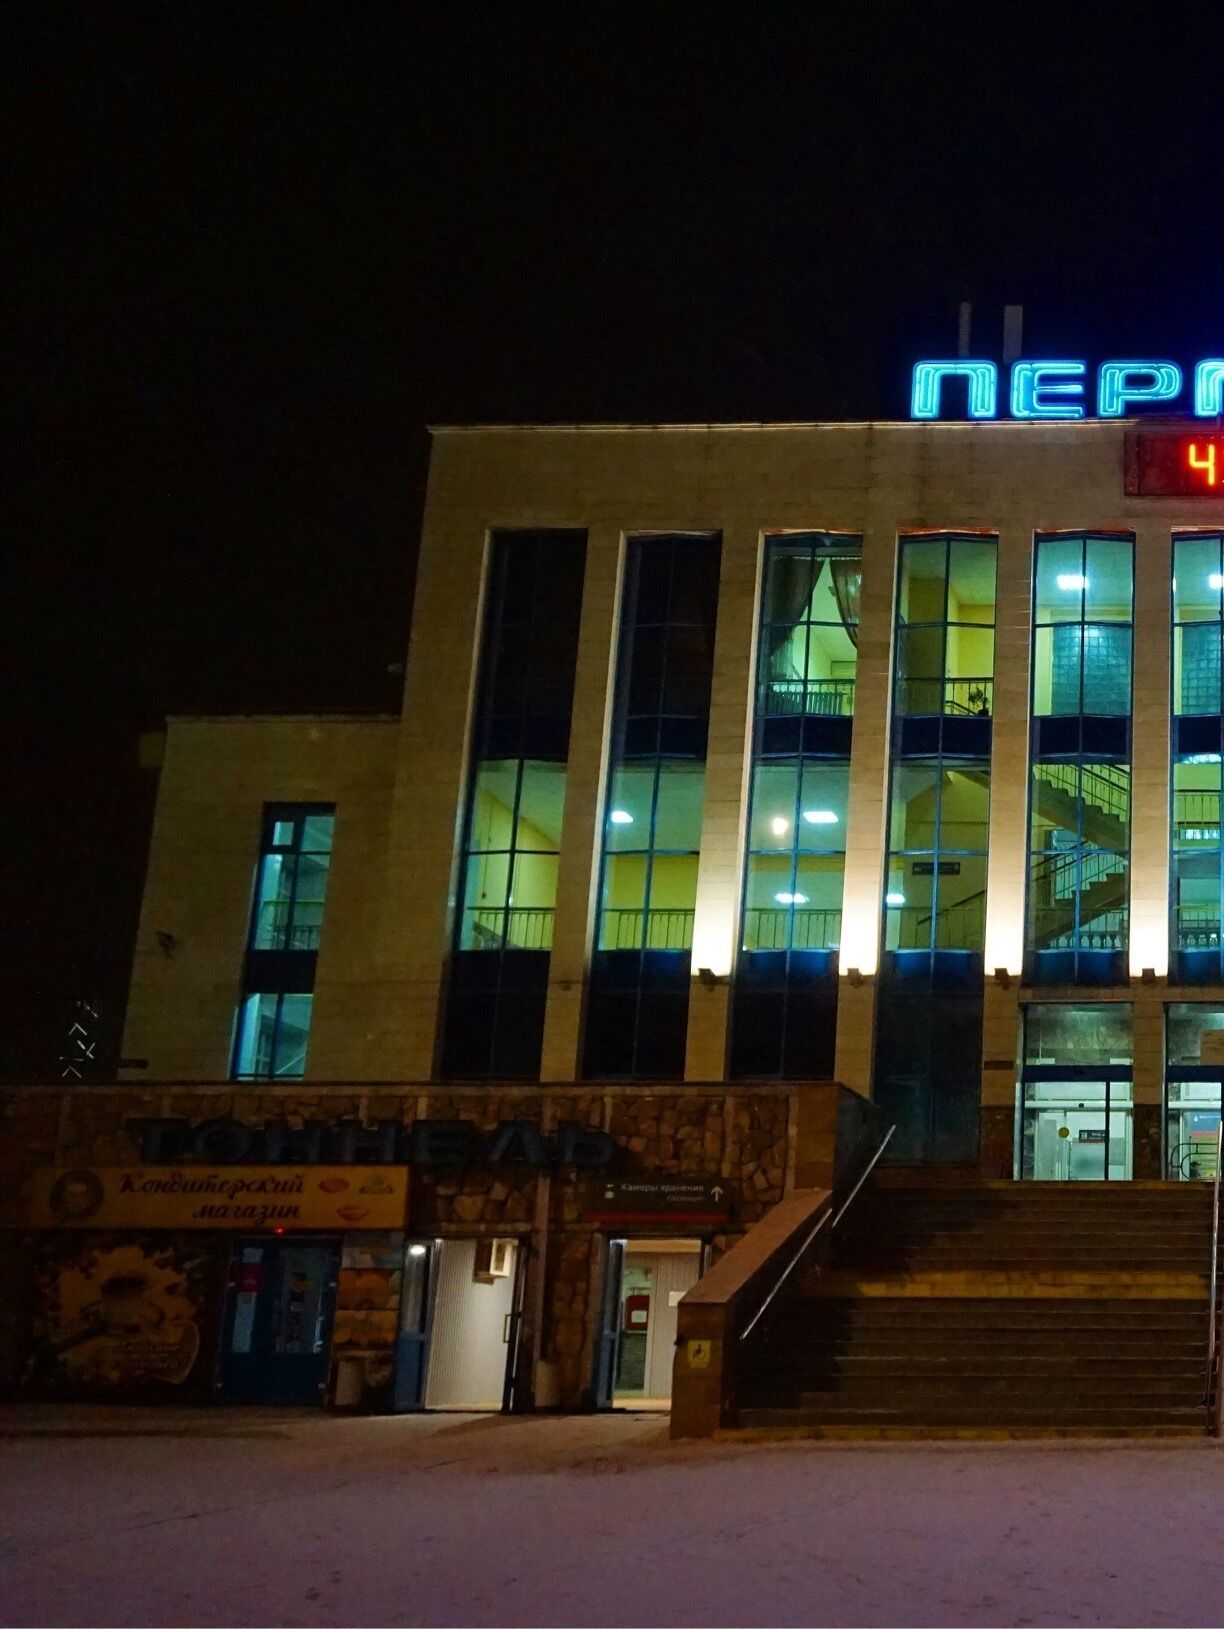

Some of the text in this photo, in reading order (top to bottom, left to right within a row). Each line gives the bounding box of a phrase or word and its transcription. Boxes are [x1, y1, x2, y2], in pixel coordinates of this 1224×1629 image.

[127, 1119, 627, 1165] ТОННЕЛЬ
[119, 1171, 305, 1200] Кондитерский
[192, 1204, 301, 1227] магазин
